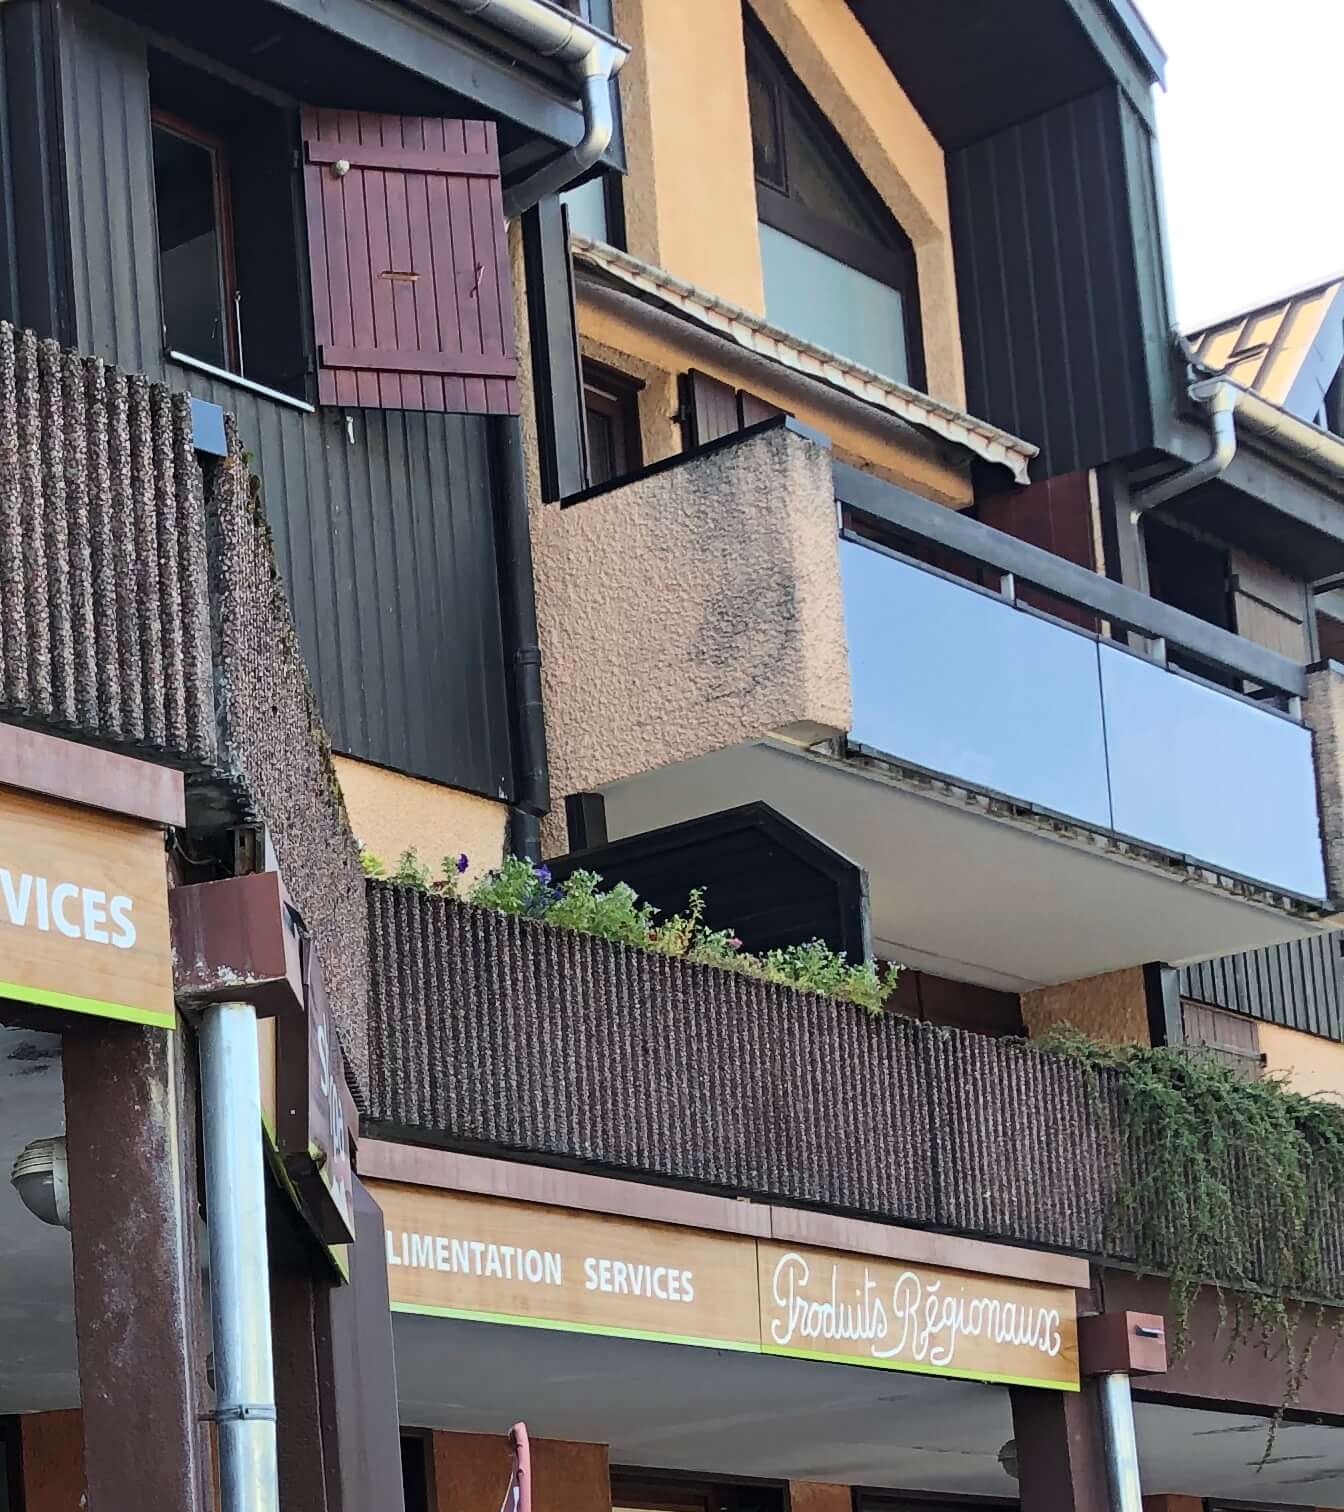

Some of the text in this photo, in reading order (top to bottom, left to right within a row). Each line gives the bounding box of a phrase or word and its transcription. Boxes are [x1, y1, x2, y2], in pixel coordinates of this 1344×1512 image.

[386, 1230, 694, 1302] LIMENTATION SERVICES
[771, 1252, 1061, 1366] Produits Régionaux
